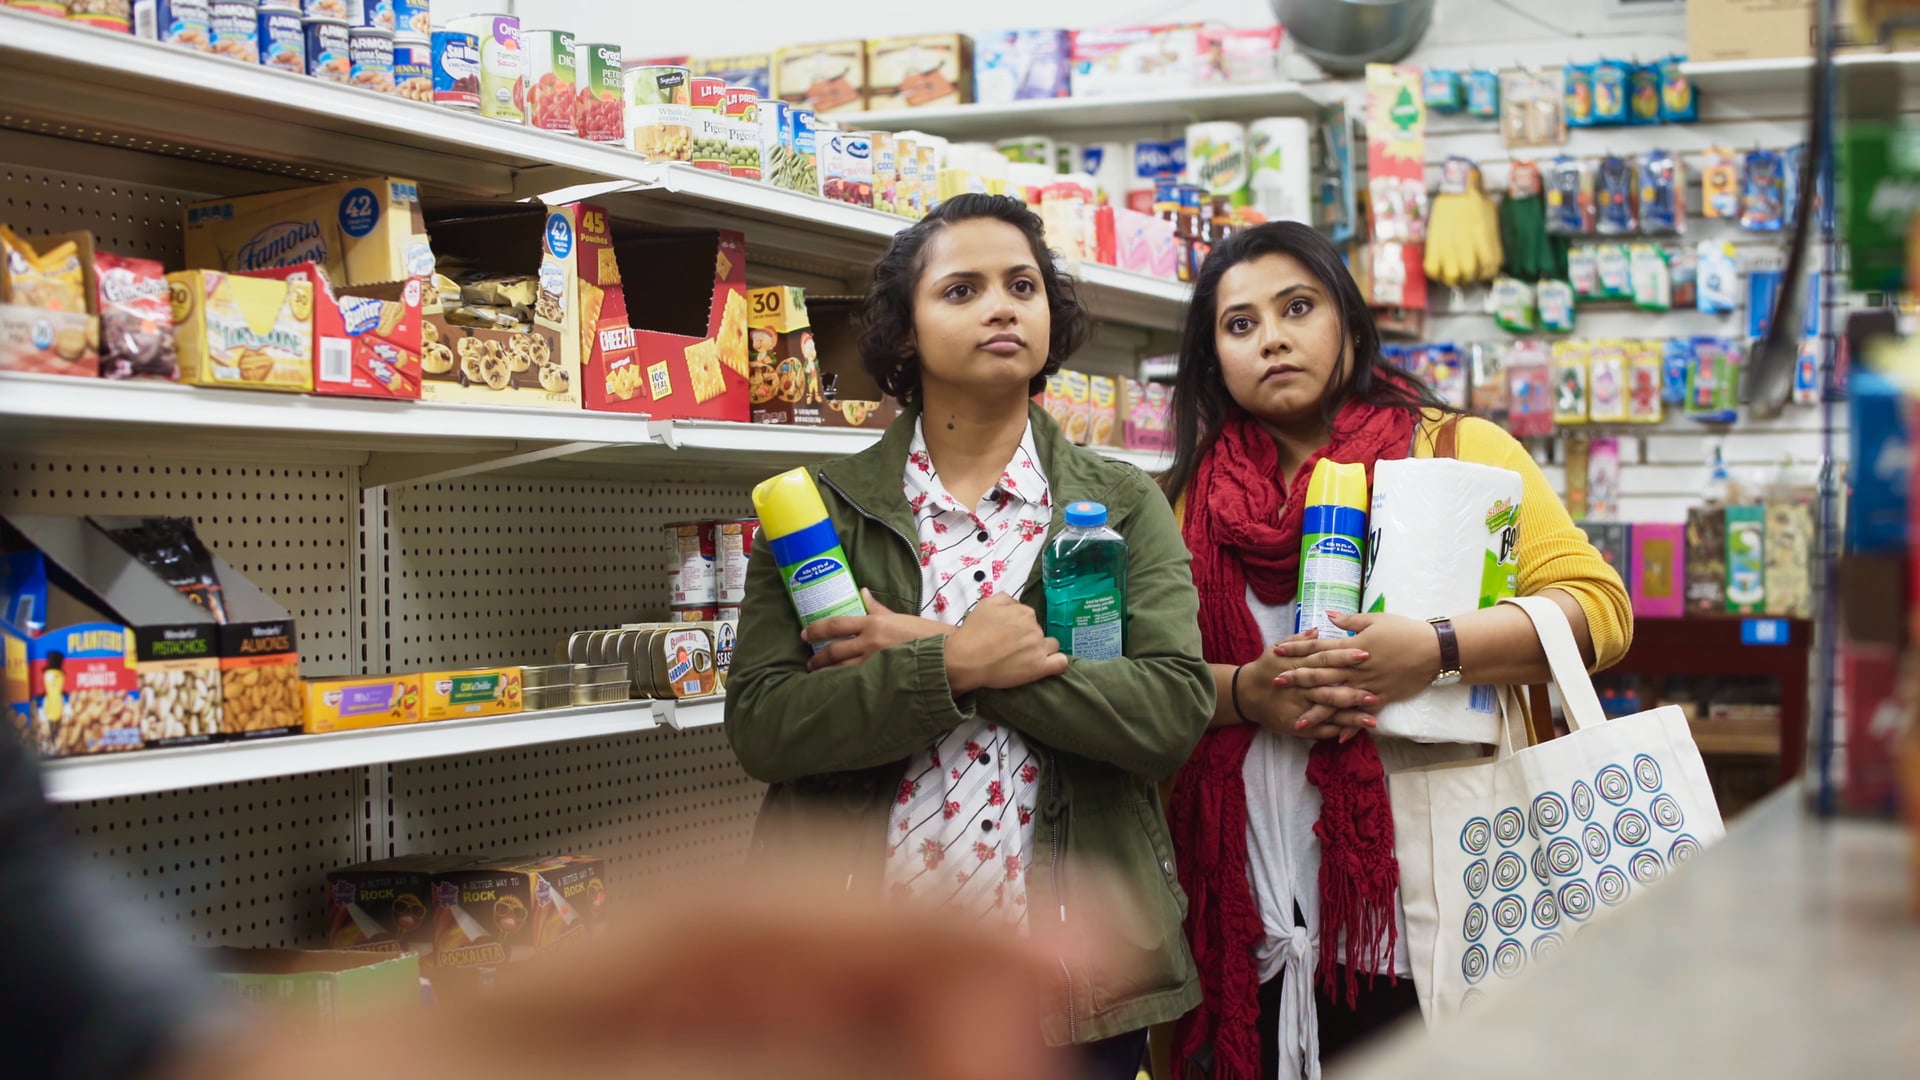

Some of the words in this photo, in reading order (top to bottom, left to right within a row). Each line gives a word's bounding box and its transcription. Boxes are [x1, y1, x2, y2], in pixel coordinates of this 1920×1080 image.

[701, 86, 712, 98] LA
[727, 93, 737, 106] LA
[345, 195, 372, 217] 42
[582, 211, 605, 234] 45
[550, 221, 568, 241] 42
[580, 233, 608, 245] Pouches
[237, 218, 321, 268] Famous
[752, 291, 781, 314] 30
[152, 639, 208, 655] PISTACHIOS
[239, 636, 290, 653] ALMONDS
[76, 671, 118, 688] PEANUTS
[469, 879, 494, 889] BETTER
[495, 879, 508, 888] WAY
[511, 877, 520, 886] TO
[562, 873, 579, 885] BETTER
[579, 870, 588, 880] WAY
[360, 887, 395, 902] ROCK
[463, 890, 496, 903] ROCK
[563, 882, 586, 898] ROCK
[440, 946, 500, 967] ROCKALETA
